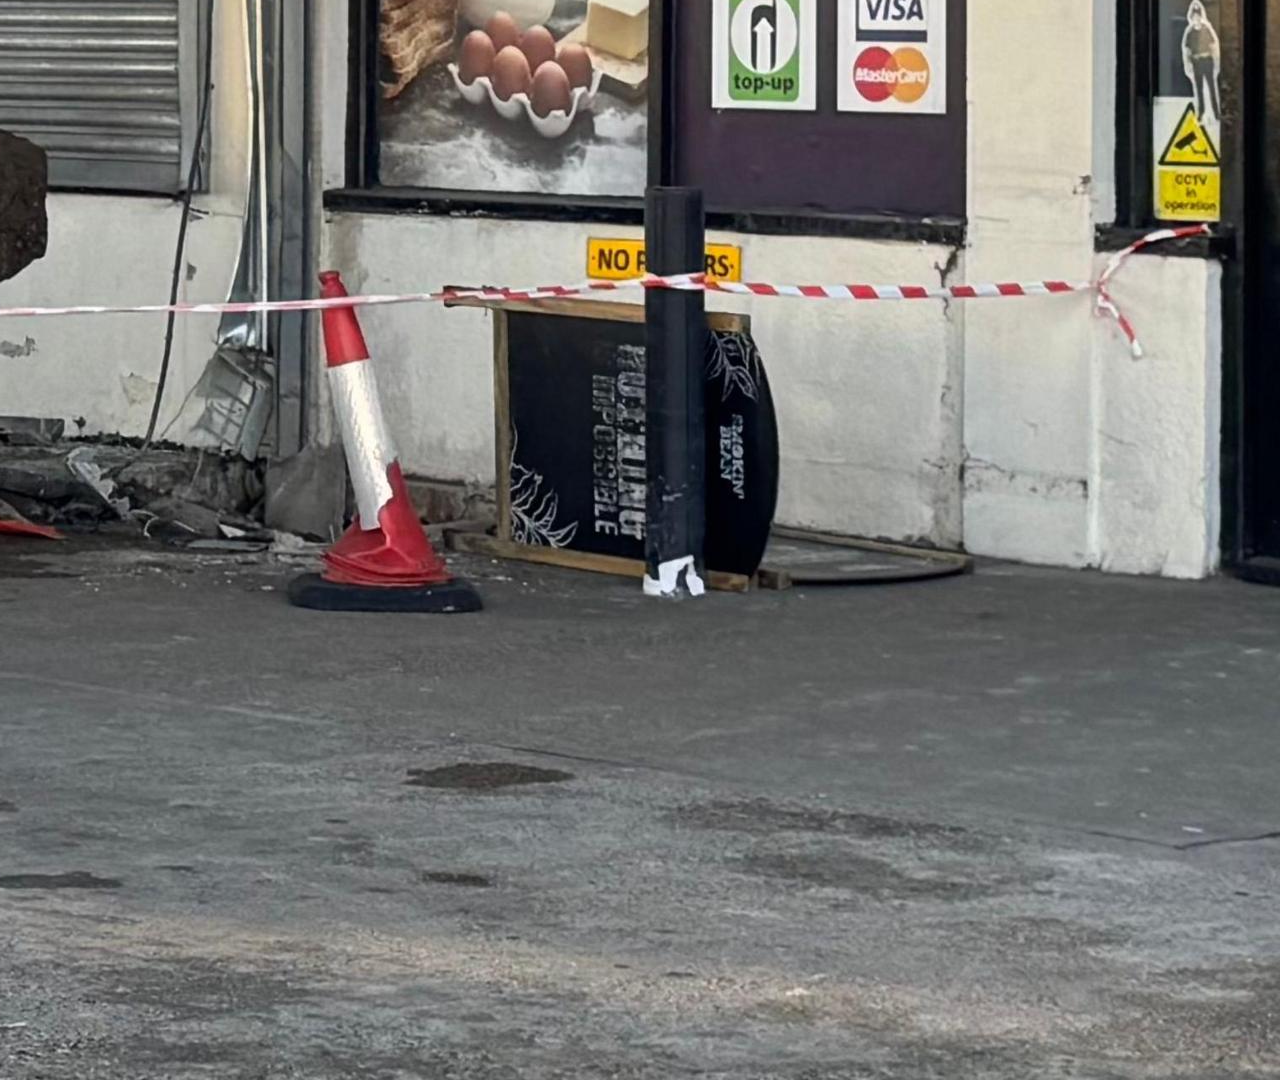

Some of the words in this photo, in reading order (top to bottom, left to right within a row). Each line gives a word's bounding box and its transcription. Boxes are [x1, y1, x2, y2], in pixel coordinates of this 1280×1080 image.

[734, 72, 794, 96] top-up
[855, 67, 930, 86] MasterCard
[1174, 174, 1208, 186] CCTV
[1185, 187, 1197, 198] in
[1164, 201, 1217, 214] operation
[598, 248, 630, 271] NO
[720, 425, 733, 480] BEAN
